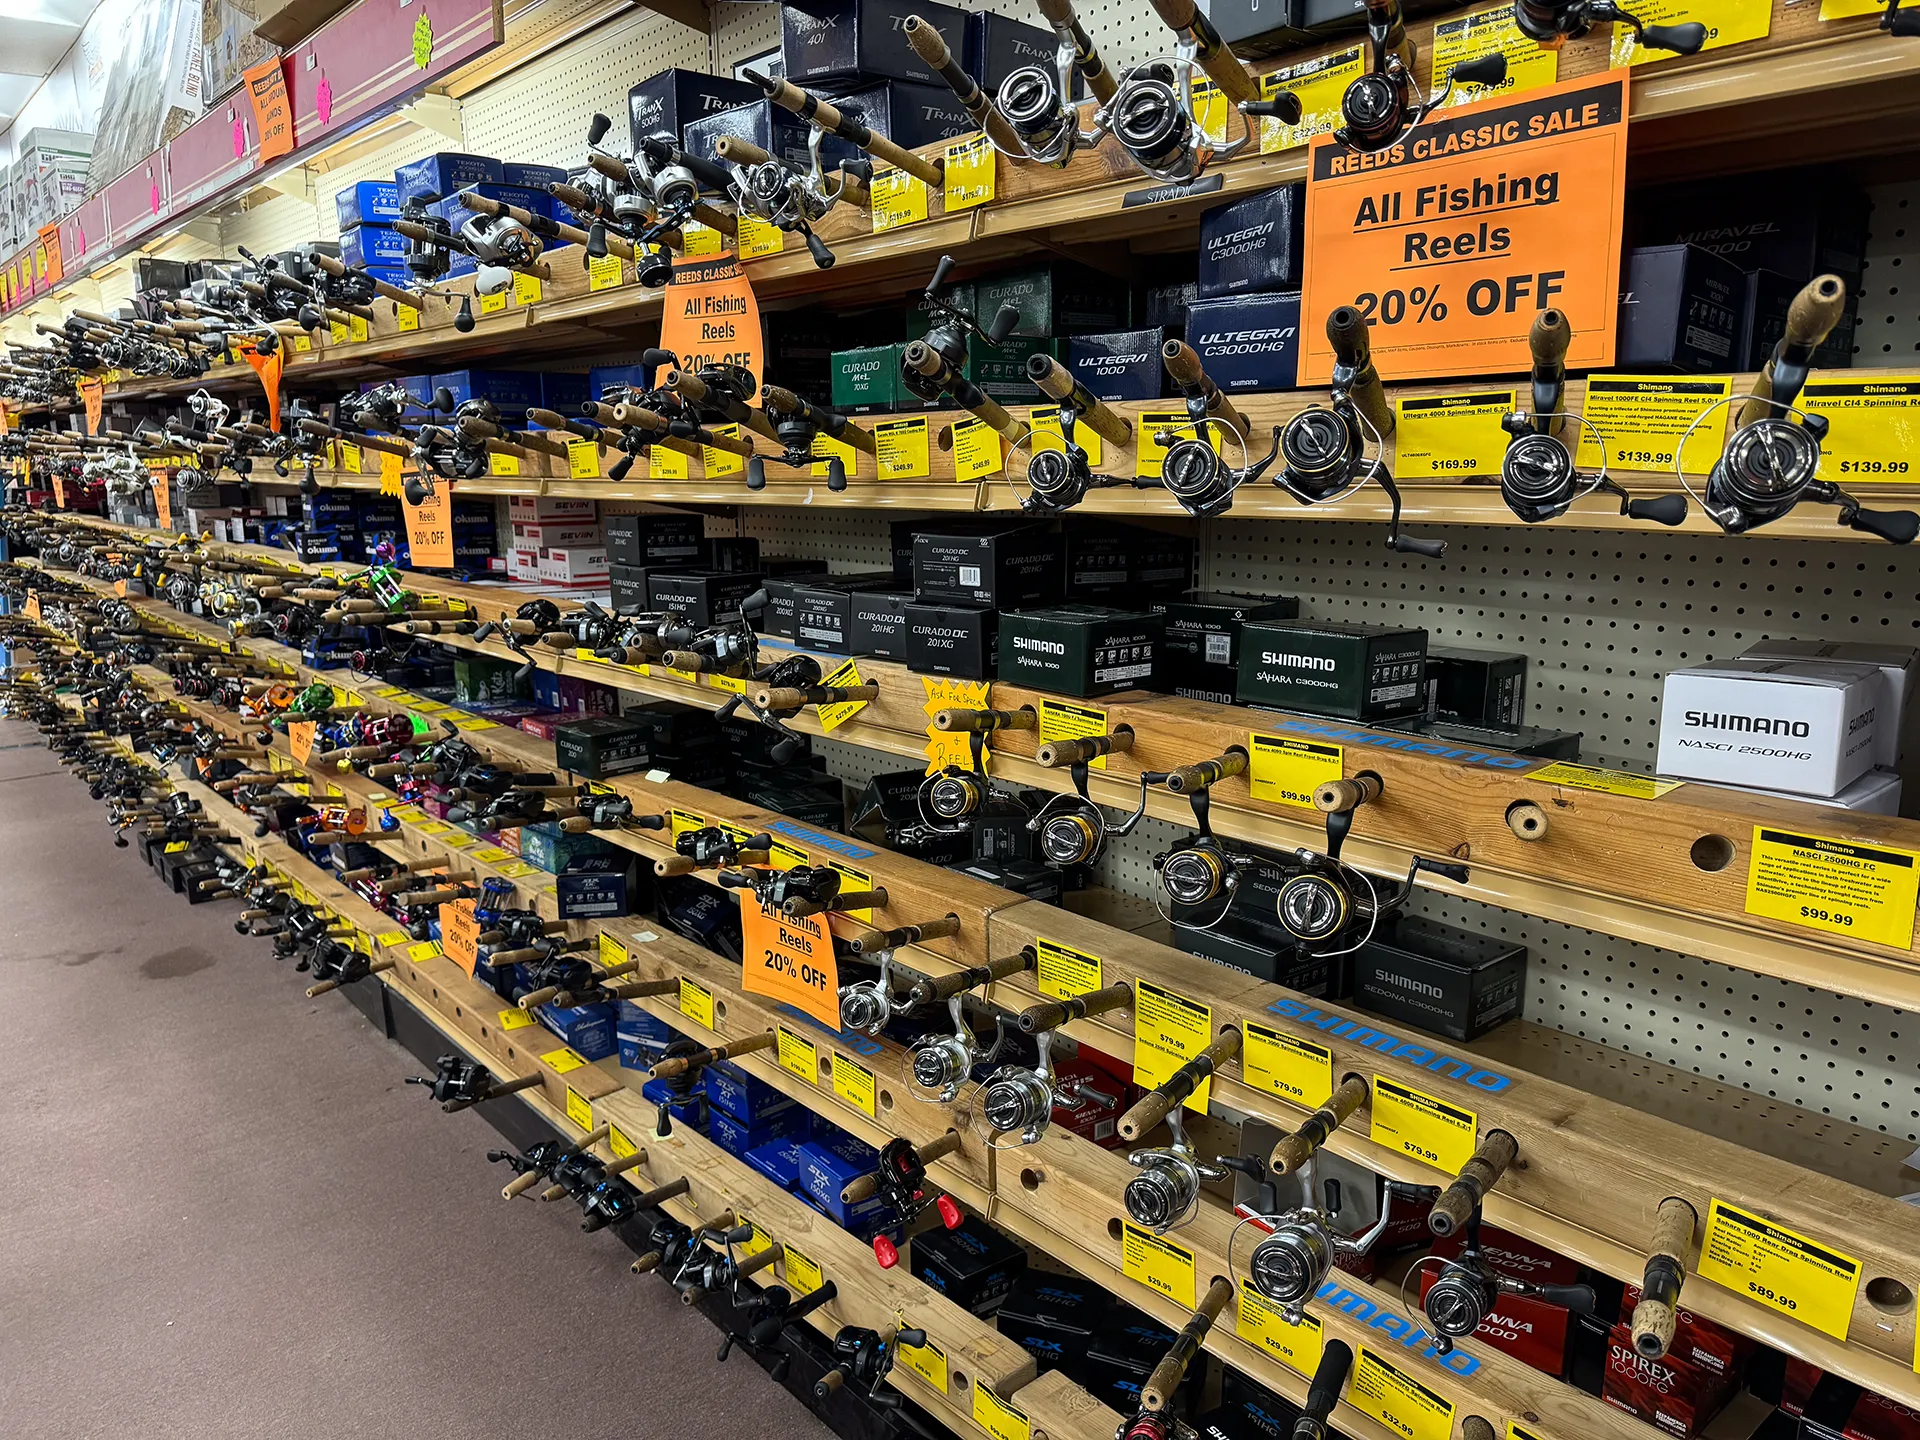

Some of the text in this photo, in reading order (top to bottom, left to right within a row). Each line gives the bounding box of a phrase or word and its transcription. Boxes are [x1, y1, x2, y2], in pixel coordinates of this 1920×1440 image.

[807, 32, 827, 46] 401
[905, 70, 930, 80] SHIMANO
[640, 113, 661, 129] 500HG
[1330, 102, 1600, 176] REEDS CLASSIC SALE
[456, 160, 486, 168] TEKOTA
[522, 169, 552, 177] TEKOTA
[498, 190, 530, 199] TEKOTA
[1146, 183, 1198, 205] STRADIC
[1354, 170, 1560, 228] All Fishing
[1207, 221, 1275, 251] ULTEGRA
[1674, 222, 1781, 244] MIRAVEL
[1210, 237, 1267, 262] C3000HG
[1403, 223, 1512, 264] Reels
[675, 263, 735, 284] REEDS CLASSIC
[1228, 278, 1249, 289] SHIMANO
[1705, 278, 1730, 295] MIRAVEL
[989, 284, 1033, 299] CURADO
[1353, 270, 1566, 327] 20% OFF
[684, 295, 747, 316] All Fishing
[702, 321, 735, 340] Reels
[1199, 326, 1296, 345] ULTEGRA
[1204, 340, 1285, 357] C3000HG
[842, 361, 880, 374] CURADO
[1078, 353, 1149, 368] ULTEGRA
[1095, 365, 1126, 377] 1000
[853, 382, 869, 391] 70XG
[1230, 379, 1259, 387] SHIMANO
[1637, 383, 1673, 392] Shimano
[1863, 385, 1907, 393] Shimano
[1441, 398, 1471, 406] Shimano
[1653, 397, 1683, 405] Spinning
[1863, 399, 1907, 407] Spinning
[1403, 406, 1511, 420] Ultegra 4000 Spinning Reel 6.2:1
[1617, 450, 1673, 463] $139.99
[1431, 459, 1477, 471] $169.99
[1840, 461, 1909, 473] $139.99
[319, 504, 350, 513] okuma
[418, 510, 436, 522] Reels
[365, 514, 395, 524] okuma
[455, 515, 488, 523] okuma
[415, 531, 445, 545] 20% OFF
[307, 545, 338, 555] okuma
[456, 546, 490, 555] okuma
[932, 548, 955, 556] CURADO
[955, 548, 968, 556] DC
[1006, 553, 1054, 566] CURADO DC
[1020, 564, 1043, 574] 201HG
[655, 593, 697, 604] CURADO DC
[805, 598, 823, 606] CURADO
[857, 611, 892, 623] CURADO
[1175, 619, 1202, 629] SAHARA
[871, 623, 895, 634] 201HG
[912, 625, 968, 639] CURADO DC
[927, 638, 954, 649] 201XG
[1013, 636, 1064, 656] SHIMANO
[1105, 635, 1130, 646] SAHARA
[1017, 655, 1060, 670] SAHARA 1000
[1261, 651, 1336, 673] SHIMANO
[1375, 650, 1421, 663] SAHARA C3000HG
[1114, 681, 1133, 689] SHIMANO
[1256, 671, 1339, 690] SAHARA C3000HG
[1175, 687, 1232, 704] SHIMANO
[1684, 710, 1811, 739] SHIMANO
[560, 740, 584, 754] CURADO
[1274, 720, 1533, 769] SHIMANO
[1283, 741, 1309, 750] SHIMANO
[1678, 738, 1812, 761] NASCI 2500HG
[1280, 790, 1311, 803] $99.99
[765, 821, 875, 859] SHIMANO
[1814, 840, 1855, 855] Shimano
[1792, 848, 1876, 873] NASCI 2500HG FC
[1800, 905, 1853, 927] $99.99
[778, 927, 813, 953] Reels
[764, 949, 827, 992] 20% OFF
[1375, 969, 1443, 999] SHIMANO
[1363, 983, 1454, 1018] SEDONA C3000HG
[1160, 1033, 1185, 1051] $79.99
[1266, 999, 1511, 1092] SHIMANO
[1275, 1034, 1300, 1046] SHIMANO
[715, 1078, 736, 1095] SLX
[1273, 1079, 1303, 1097] $79.99
[720, 1090, 731, 1102] XT
[1409, 1093, 1439, 1109] SHIMANO
[1404, 1140, 1438, 1163] $79.99
[807, 1164, 830, 1186] SLX
[813, 1177, 826, 1190] XT
[810, 1184, 831, 1204] 150XG
[1766, 1227, 1803, 1248] Shimano
[1743, 1229, 1852, 1282] 1000 Spinning Reel
[923, 1267, 946, 1290] SLX
[1147, 1274, 1172, 1292] $29.99
[1748, 1281, 1797, 1310] $89.99
[1265, 1336, 1294, 1358] $29.99
[1611, 1345, 1676, 1386] SPIREX
[1611, 1358, 1669, 1394] 1000FG
[1606, 1395, 1638, 1415] SHIMANO
[1243, 1402, 1282, 1431] SLX
[1382, 1410, 1414, 1437] $32.99
